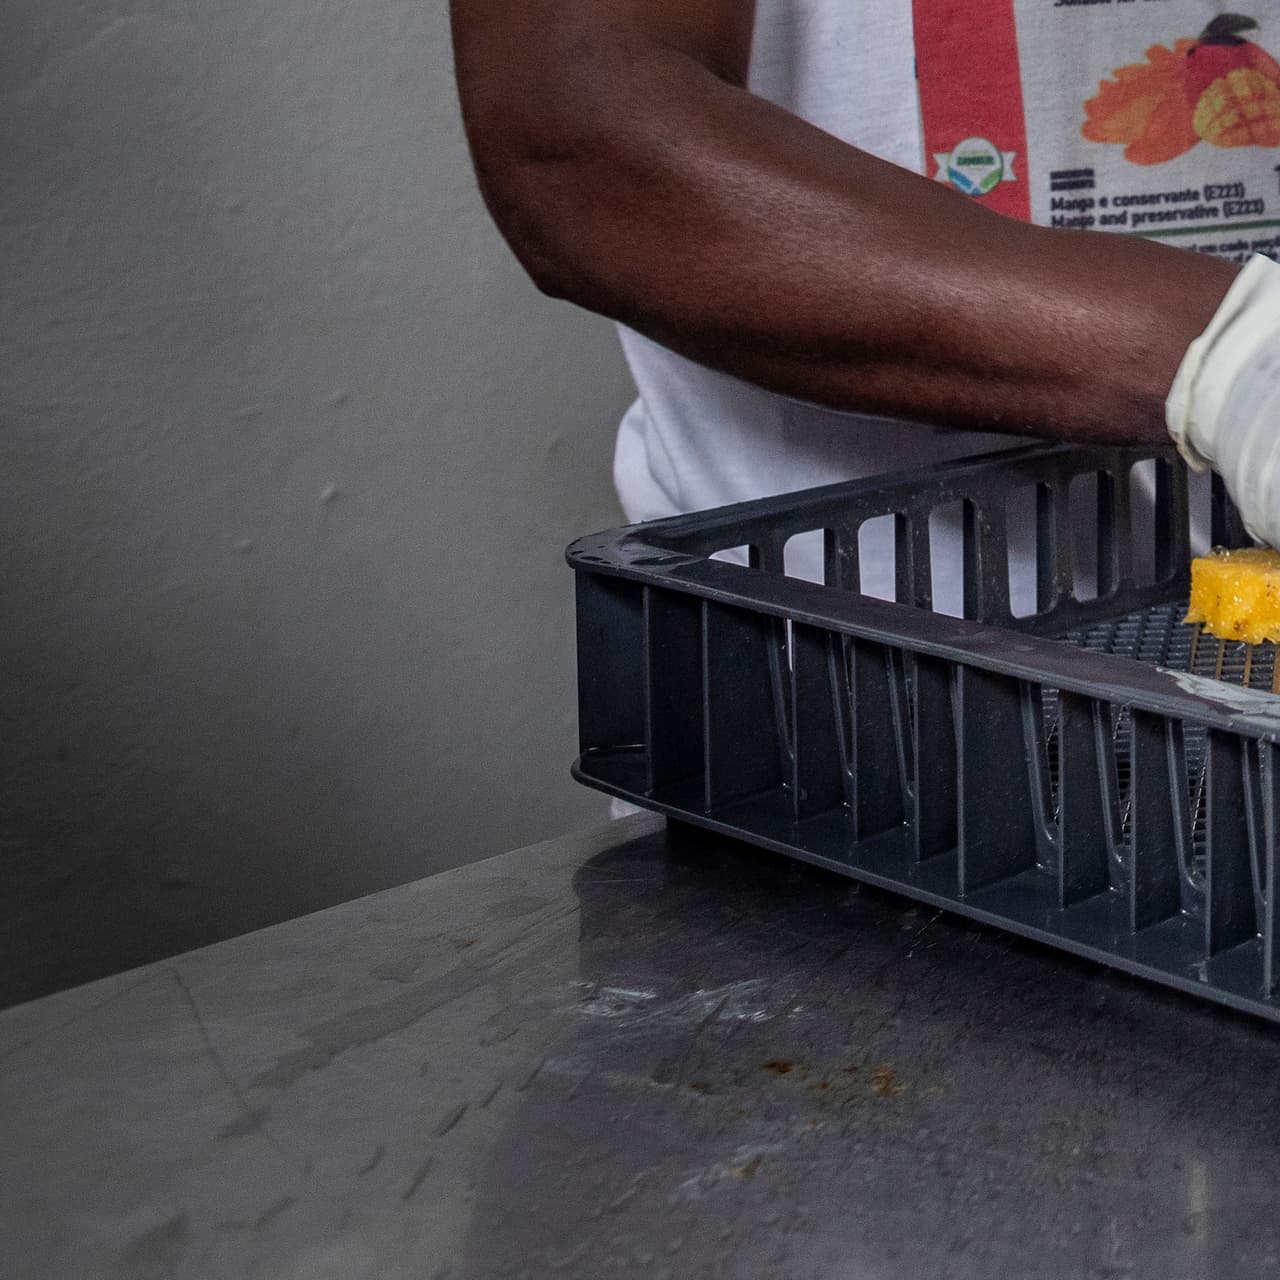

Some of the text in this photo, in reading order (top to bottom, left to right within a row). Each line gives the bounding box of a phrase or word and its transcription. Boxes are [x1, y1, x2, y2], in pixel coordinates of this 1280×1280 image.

[1050, 182, 1245, 212] Manga e conservante (E223)
[1099, 210, 1127, 226] and
[1132, 205, 1219, 227] preservative
[1223, 198, 1265, 218] (E223)
